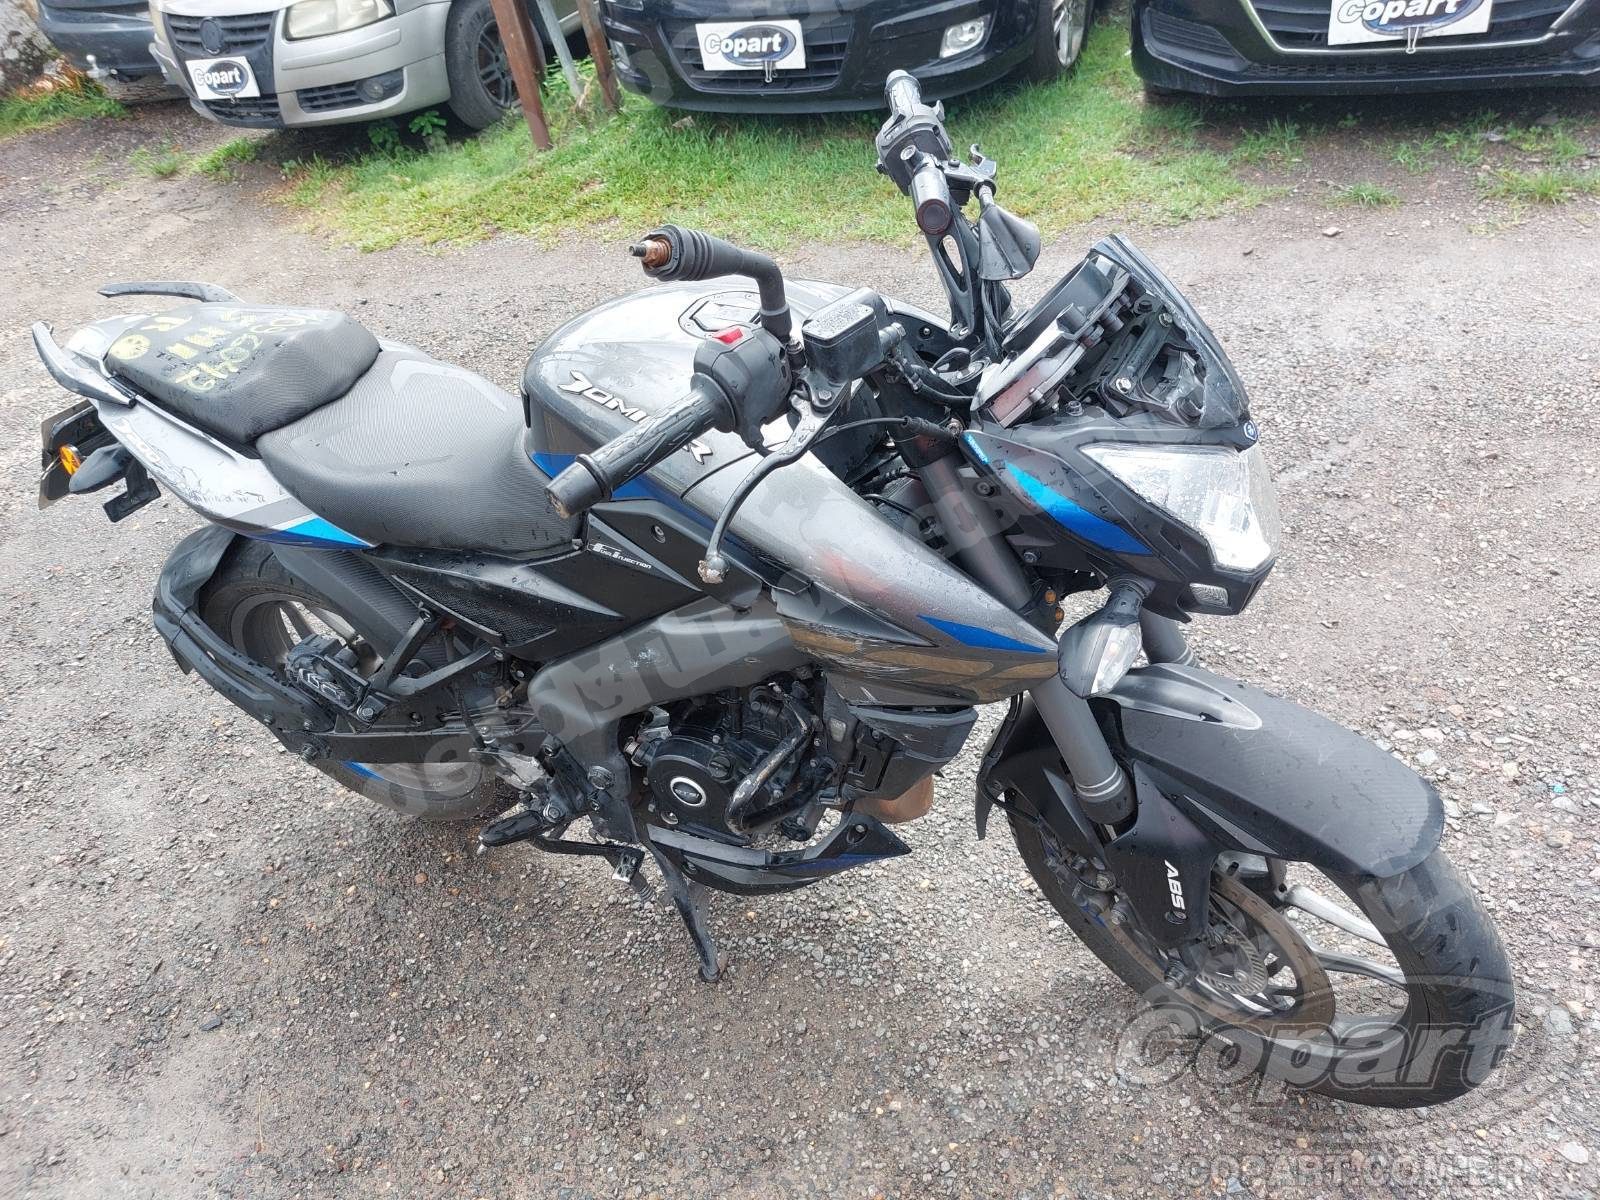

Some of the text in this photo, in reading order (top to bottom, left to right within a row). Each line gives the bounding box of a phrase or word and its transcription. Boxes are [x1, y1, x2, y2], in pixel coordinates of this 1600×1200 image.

[705, 32, 782, 57] Copart
[193, 67, 242, 88] Copart
[1164, 859, 1186, 910] ABS
